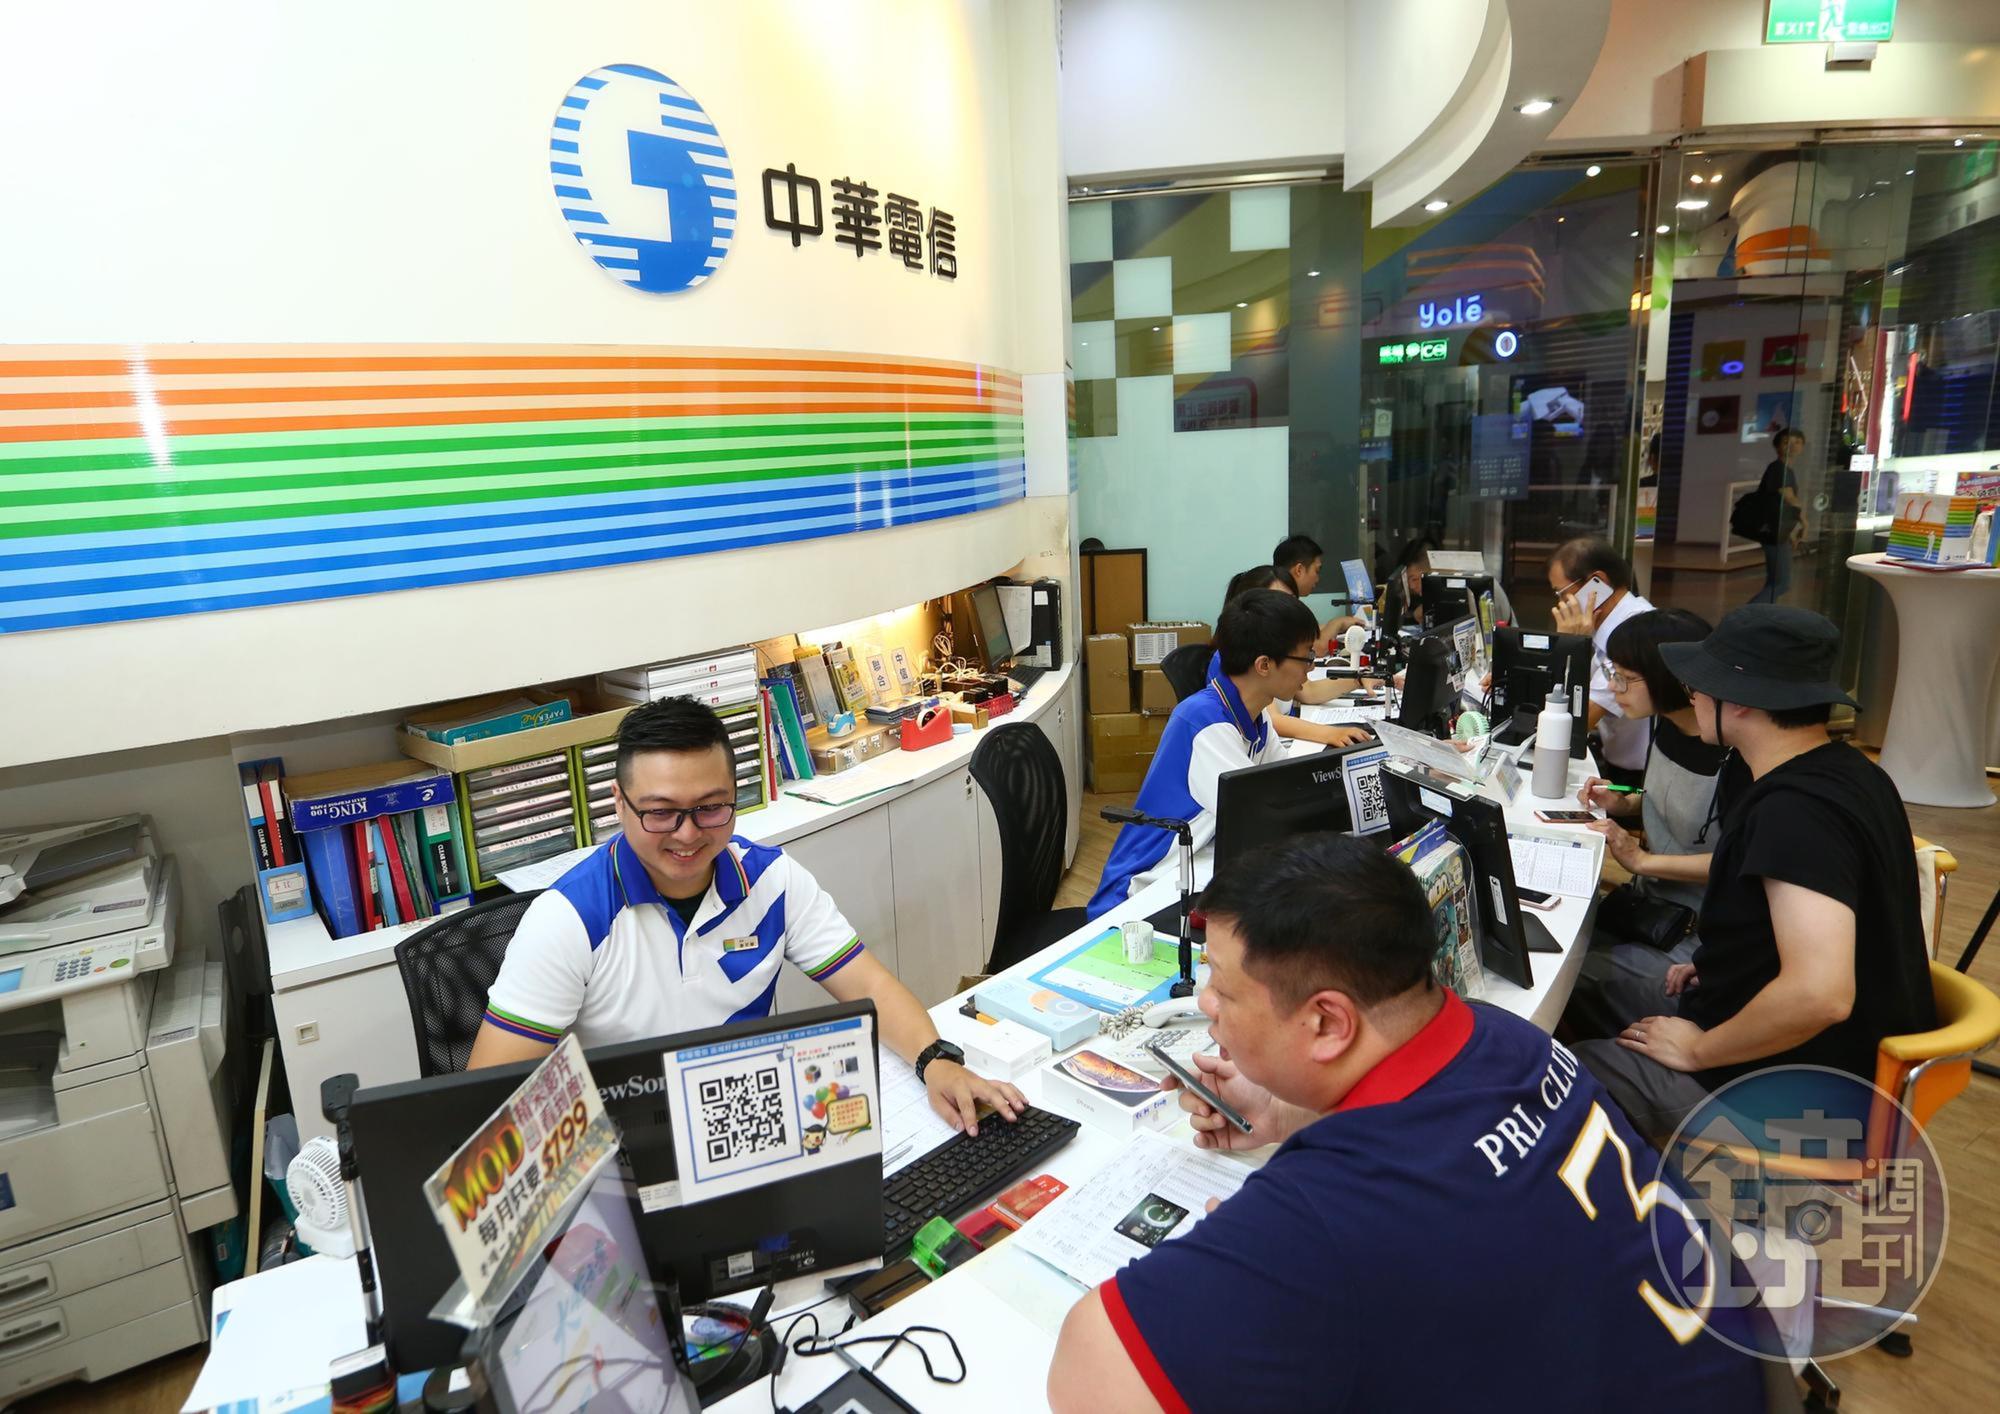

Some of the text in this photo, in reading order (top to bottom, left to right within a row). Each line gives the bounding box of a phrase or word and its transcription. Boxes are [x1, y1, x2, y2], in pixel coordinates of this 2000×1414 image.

[1774, 22, 1816, 36] EXIT
[761, 162, 958, 280] 中華電信
[310, 809, 328, 817] 100
[329, 801, 368, 819] KING
[444, 1123, 525, 1233] MOD
[1473, 1103, 1547, 1178] PRL
[478, 1159, 541, 1247] 每月只要
[1557, 1100, 1717, 1346] 3
